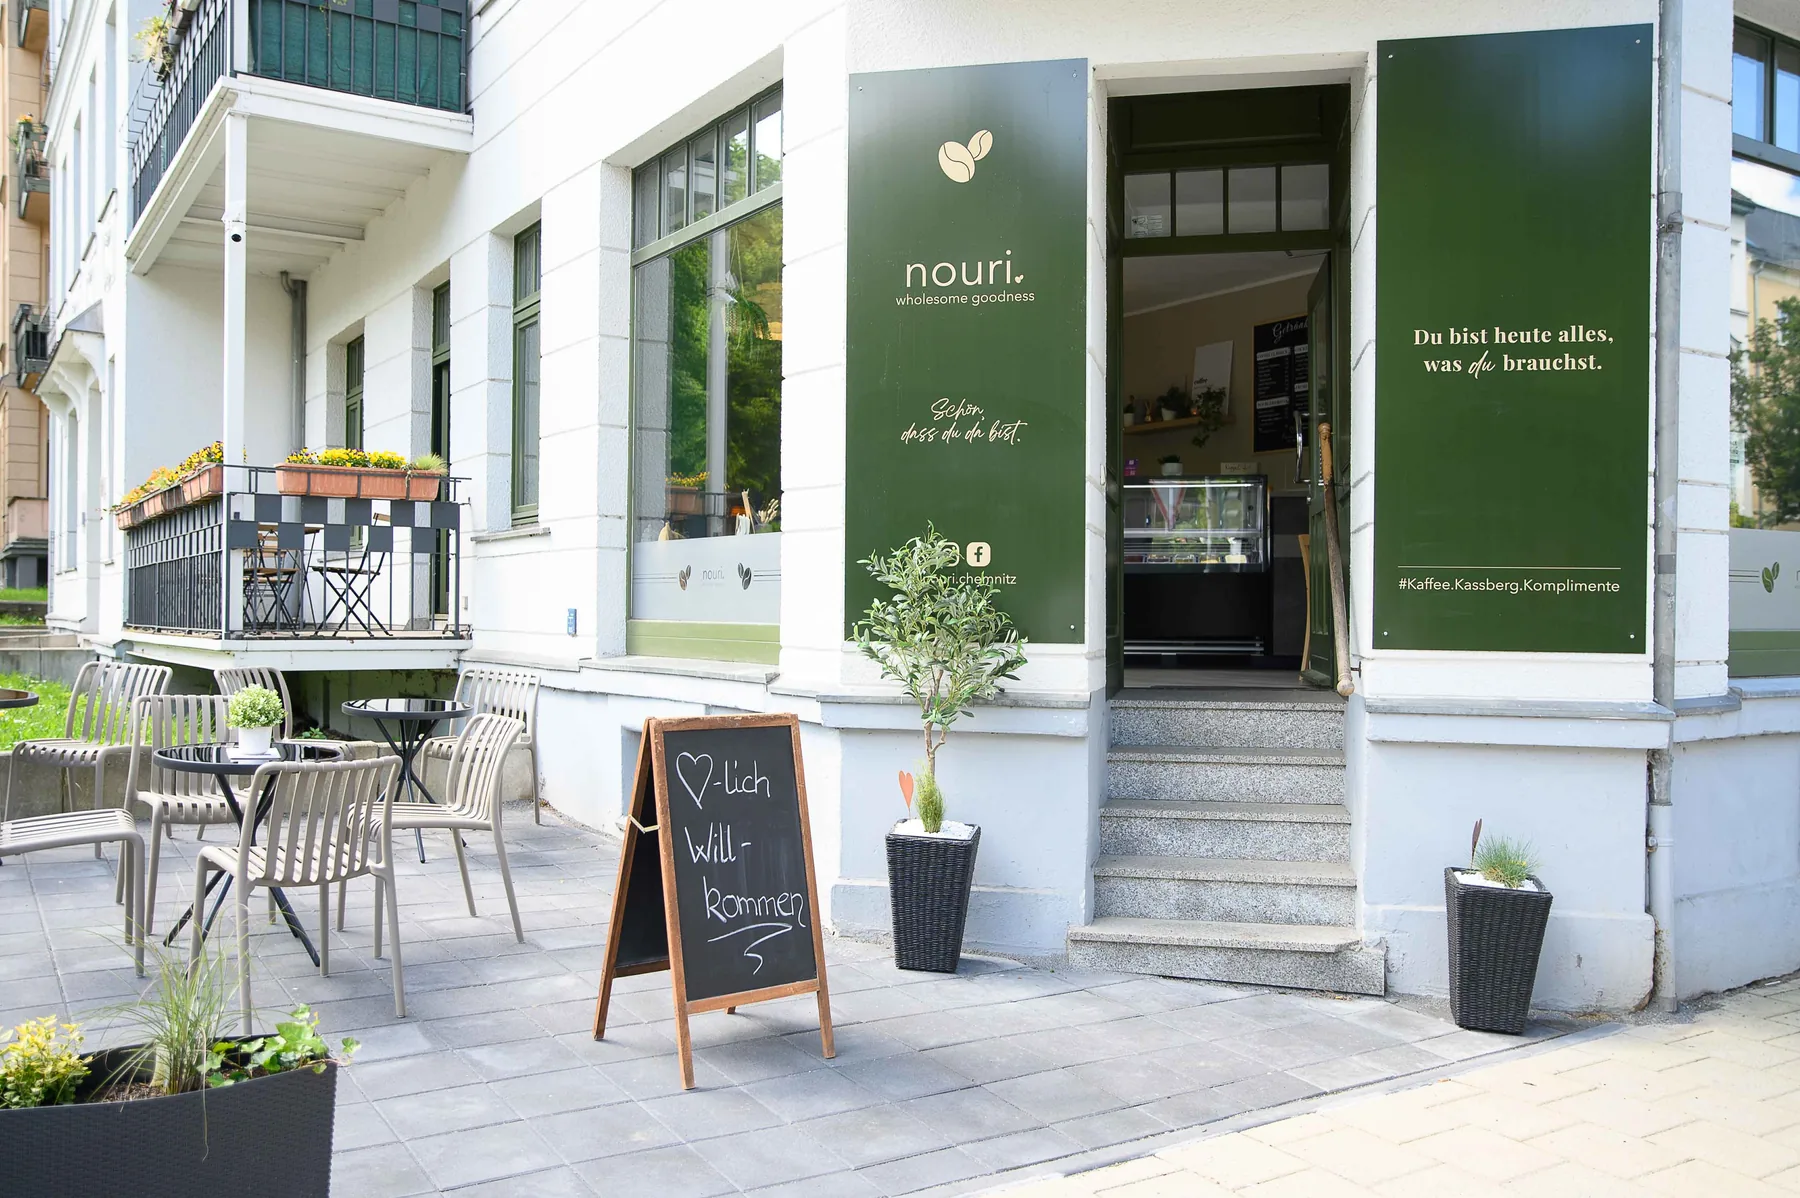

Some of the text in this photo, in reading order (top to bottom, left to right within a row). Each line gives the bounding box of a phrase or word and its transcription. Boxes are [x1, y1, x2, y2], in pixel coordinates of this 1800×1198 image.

[896, 290, 1035, 306] wholesome goodness
[1413, 325, 1614, 346] Du bist heute alles,
[1423, 350, 1603, 379] was du brauchst.
[930, 398, 985, 421] Schön,
[900, 419, 1028, 445] dass du da bist.
[923, 572, 1017, 585] ri.chemnitz
[1398, 577, 1620, 595] #Kaffee.Kassberg.Komplimente
[703, 876, 806, 928] kommen
